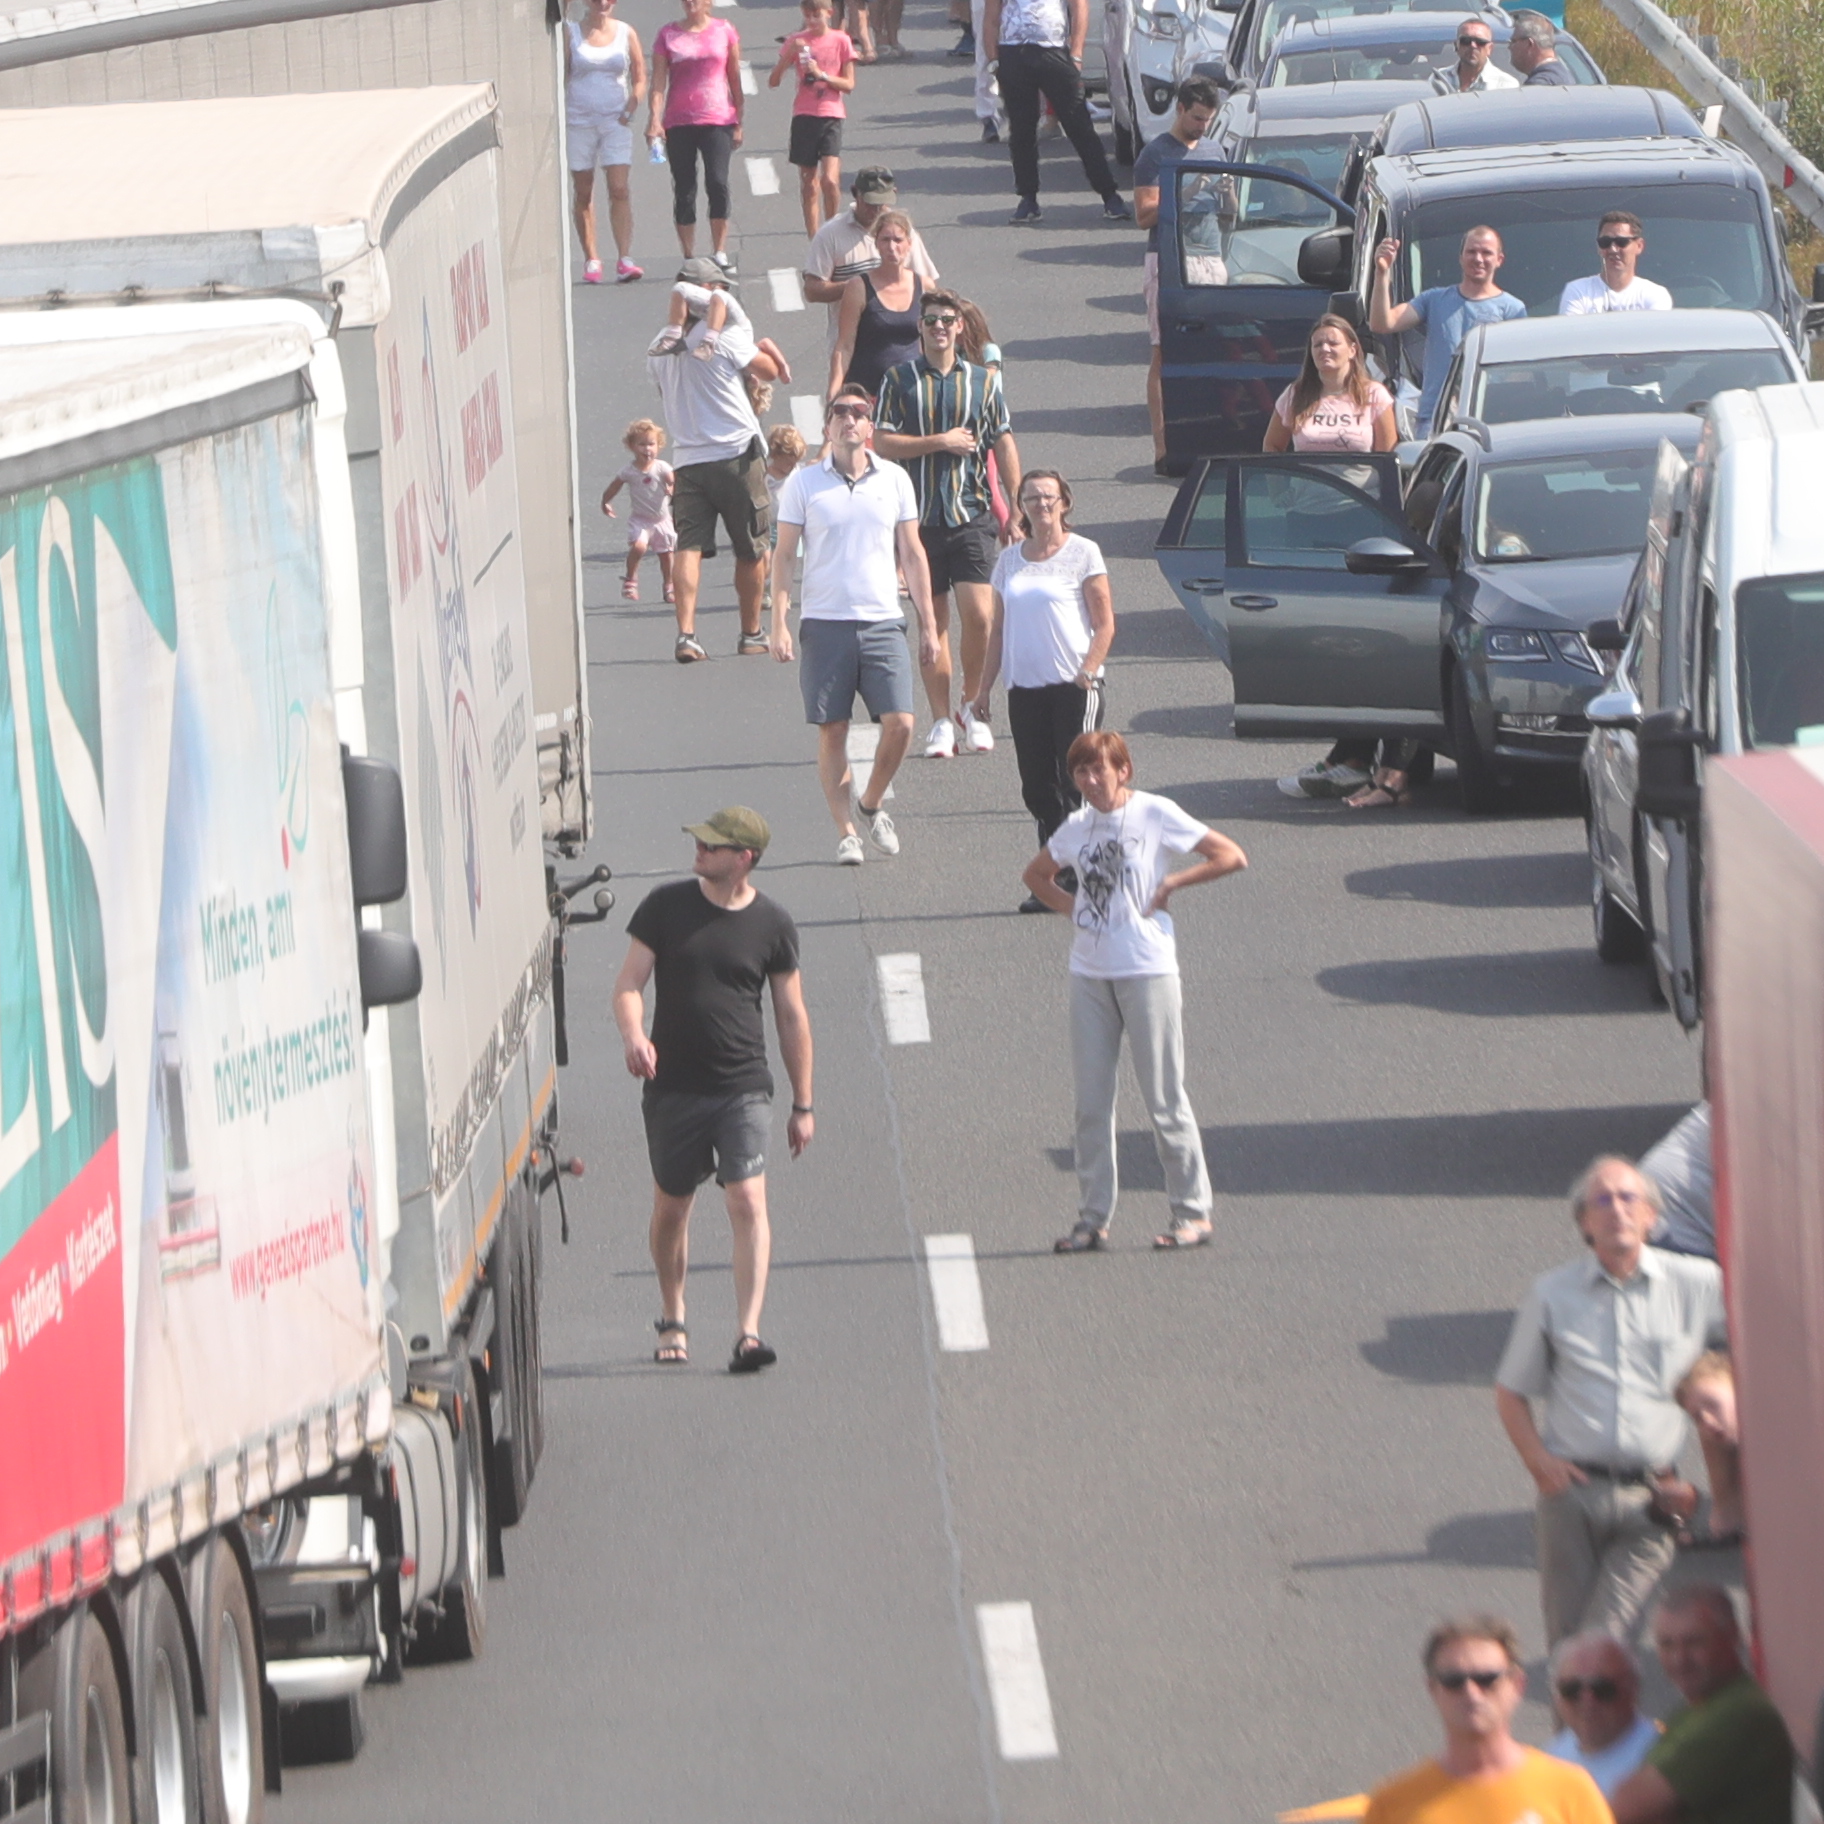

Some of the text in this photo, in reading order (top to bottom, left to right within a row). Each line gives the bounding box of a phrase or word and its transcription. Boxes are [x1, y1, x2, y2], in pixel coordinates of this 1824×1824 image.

[198, 887, 297, 986] Minden, ami
[228, 1199, 345, 1303] www.genezispartner.hu
